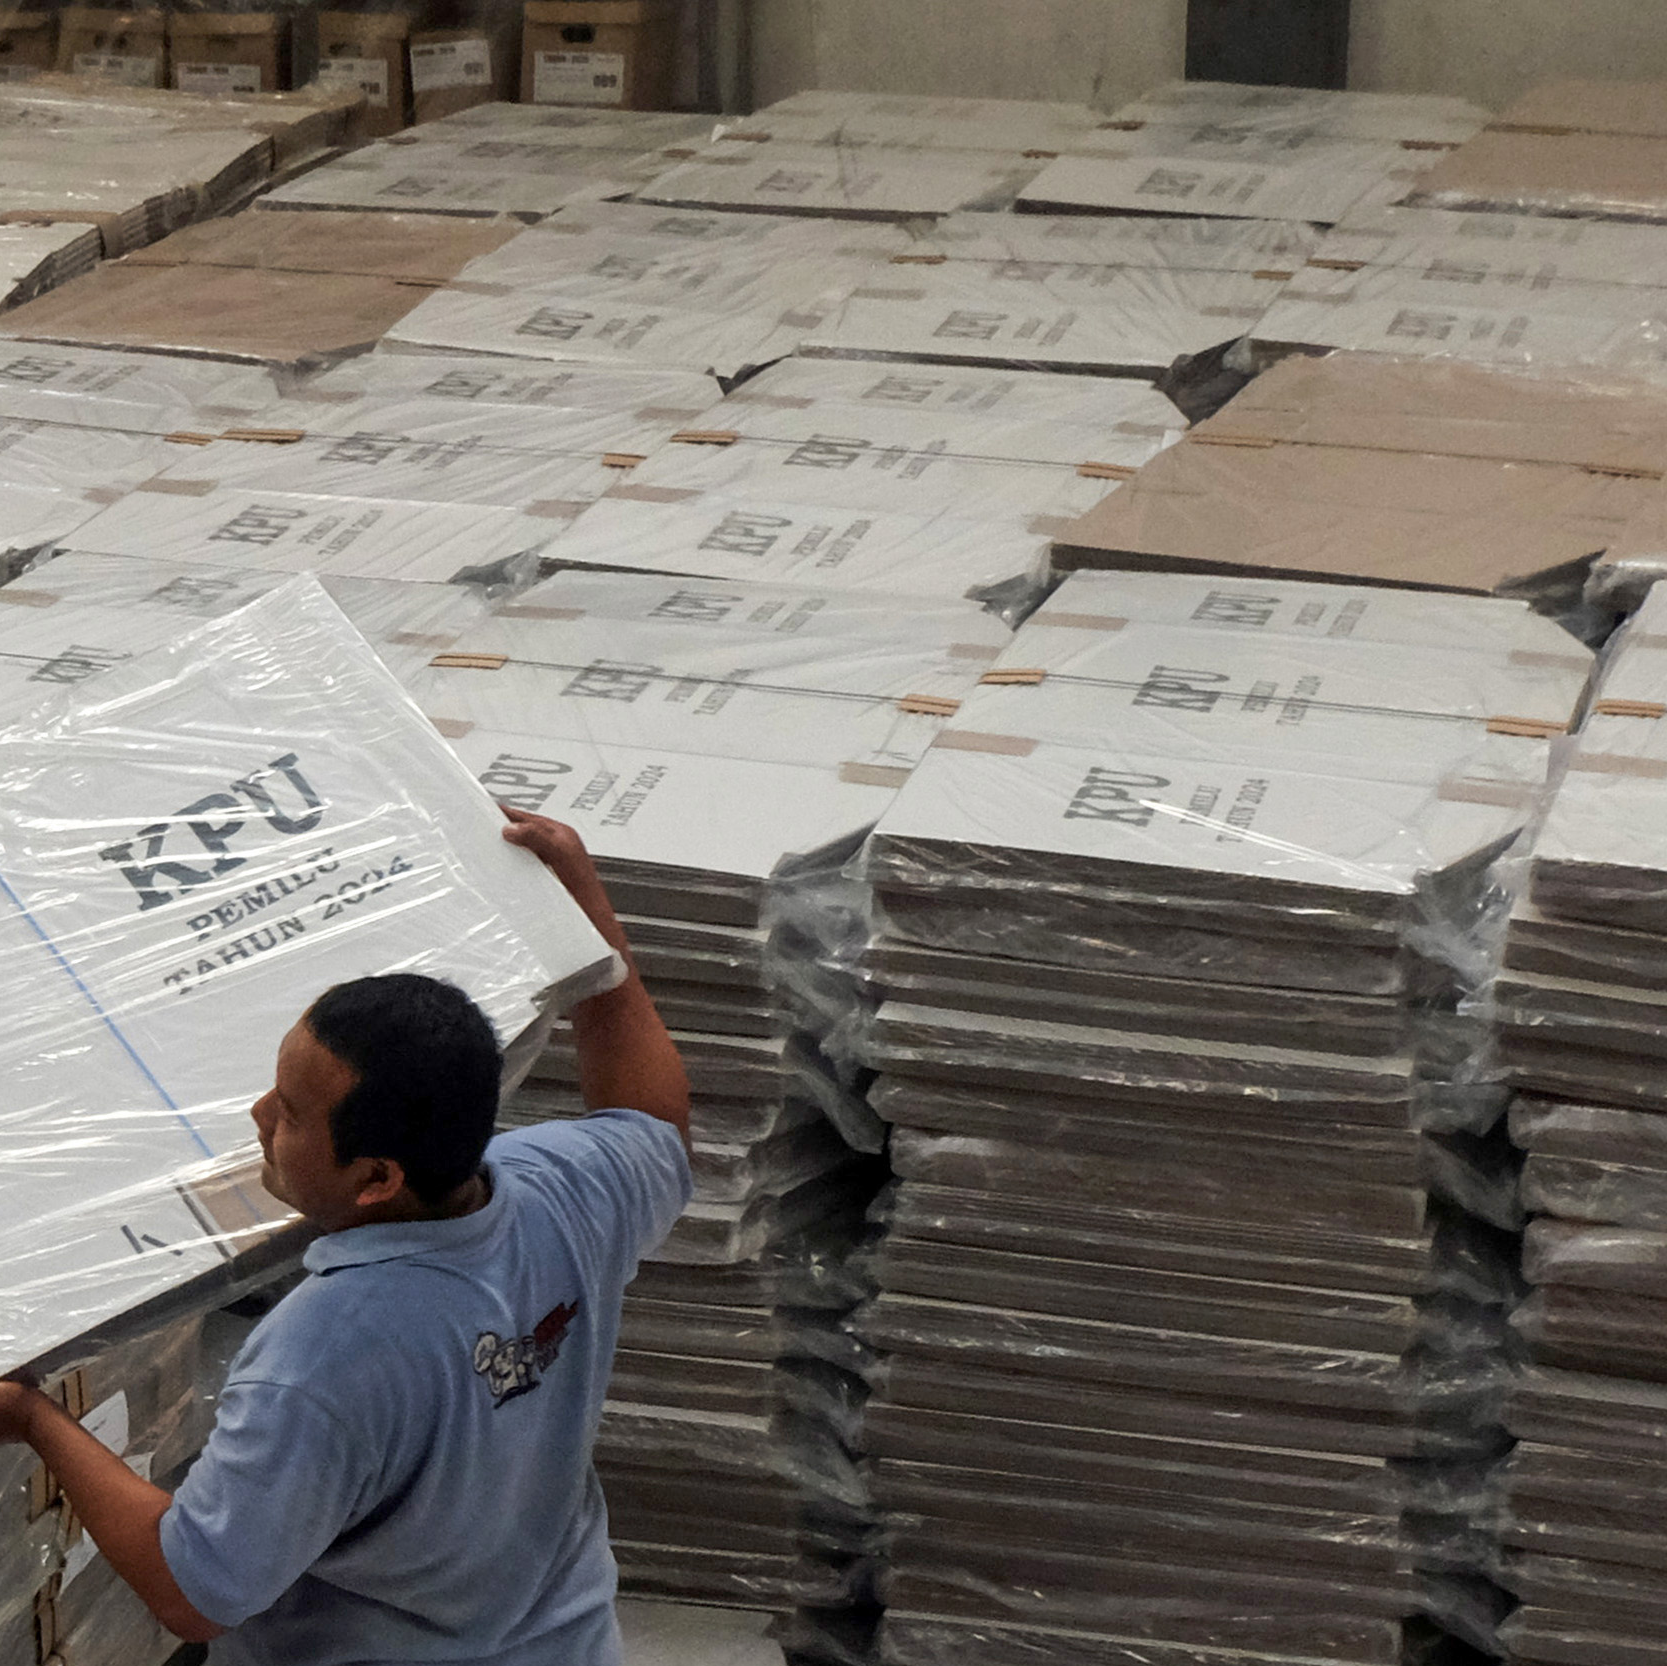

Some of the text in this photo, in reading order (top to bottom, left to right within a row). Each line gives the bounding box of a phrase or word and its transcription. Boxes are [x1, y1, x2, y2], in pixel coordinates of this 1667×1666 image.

[206, 504, 308, 546] KPU
[698, 510, 792, 556] KPU
[1131, 664, 1230, 713] KPU
[1063, 766, 1171, 828] KPU
[98, 752, 324, 911] KPU
[164, 855, 414, 996] TAHUN 2024
[186, 847, 341, 942] PEMILU
